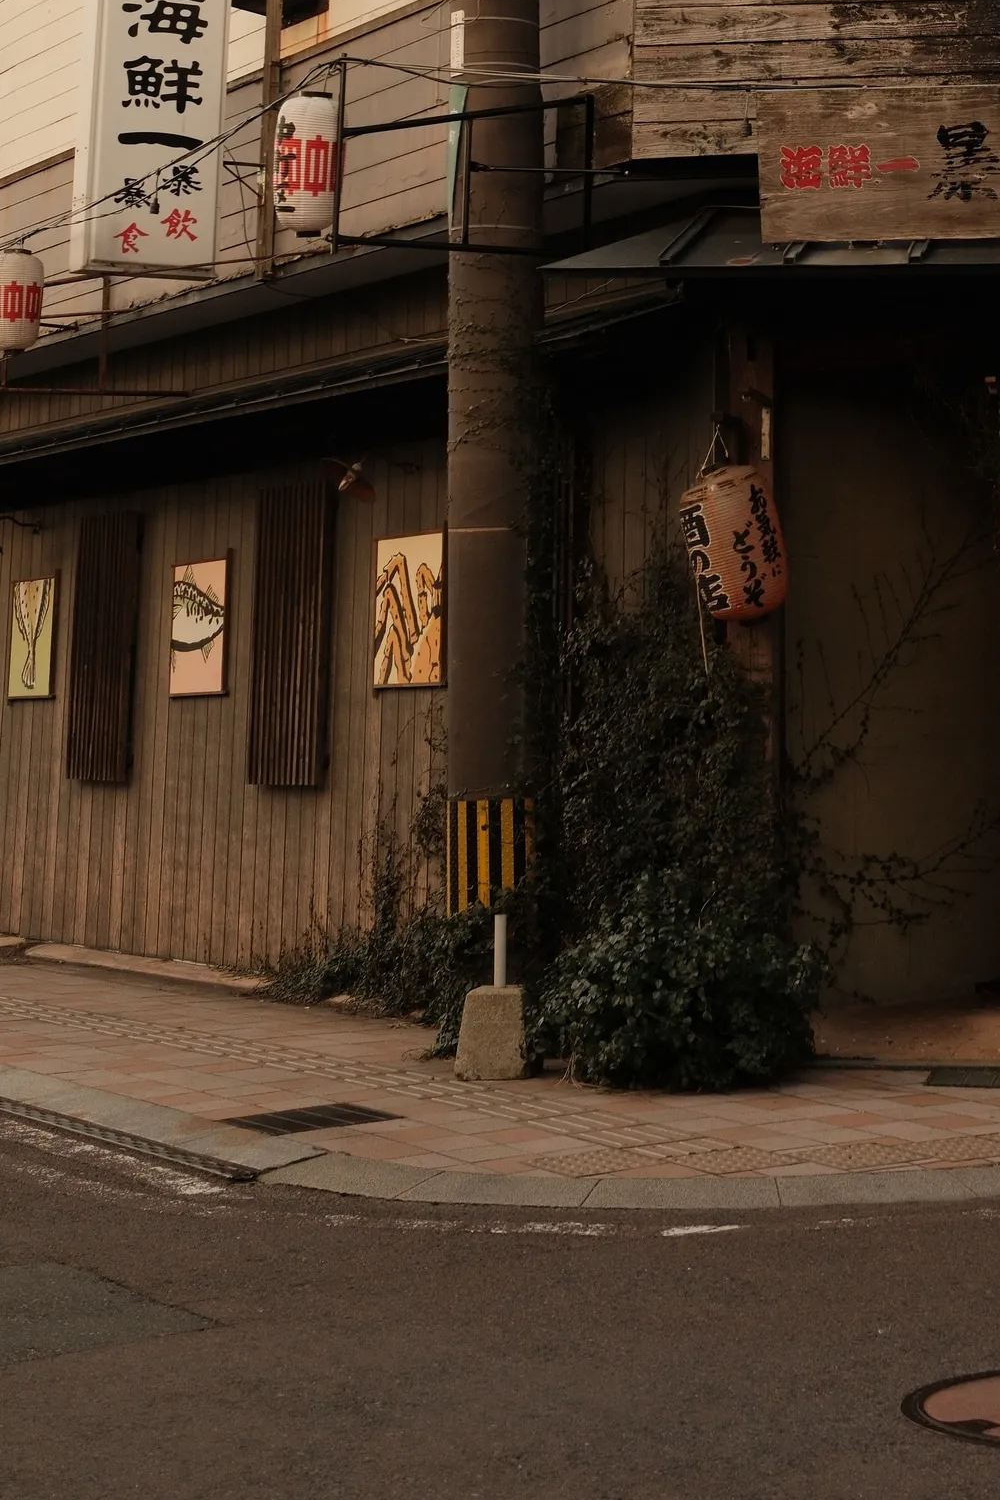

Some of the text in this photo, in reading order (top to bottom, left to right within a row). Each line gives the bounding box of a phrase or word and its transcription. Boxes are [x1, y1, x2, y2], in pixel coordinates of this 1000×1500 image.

[779, 143, 920, 190] 海鮮一
[732, 520, 768, 608] どうぞ
